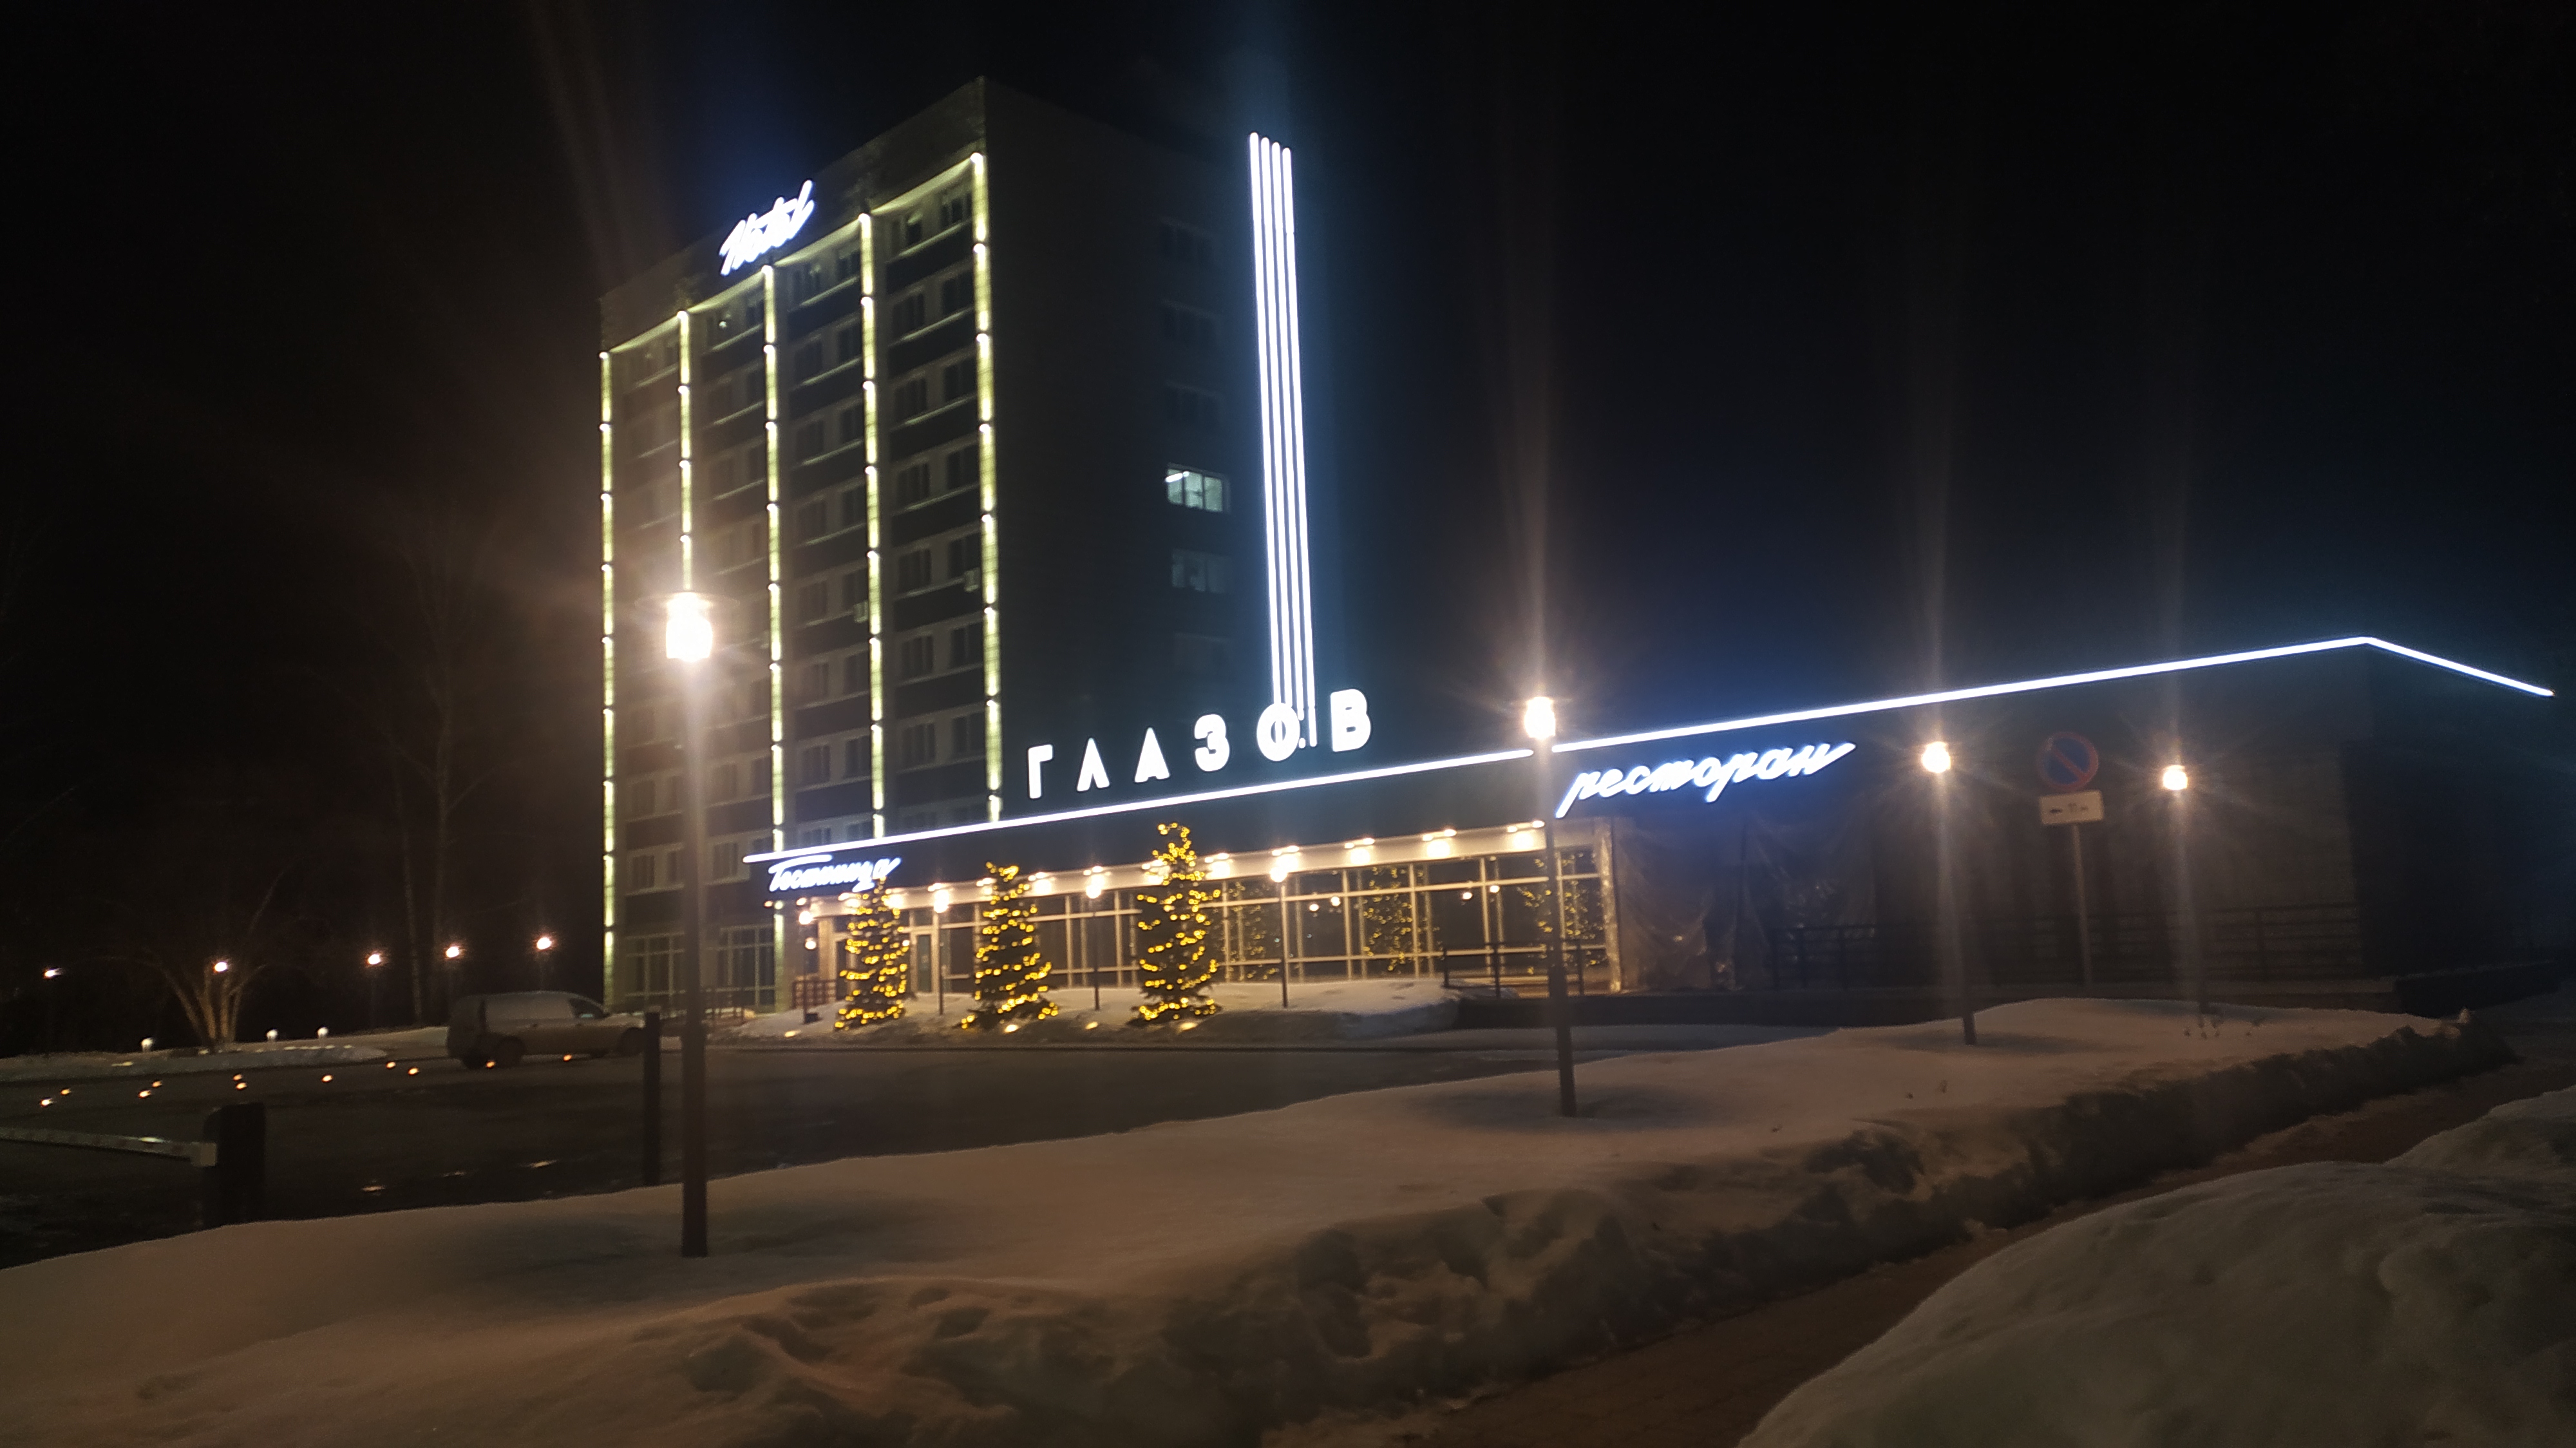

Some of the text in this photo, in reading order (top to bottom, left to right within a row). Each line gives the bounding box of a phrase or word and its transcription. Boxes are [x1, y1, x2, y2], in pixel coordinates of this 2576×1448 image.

[1028, 689, 1371, 799] ГЛАЗОВ
[1555, 743, 1856, 819] ресторан
[768, 854, 902, 893] Гостиница
